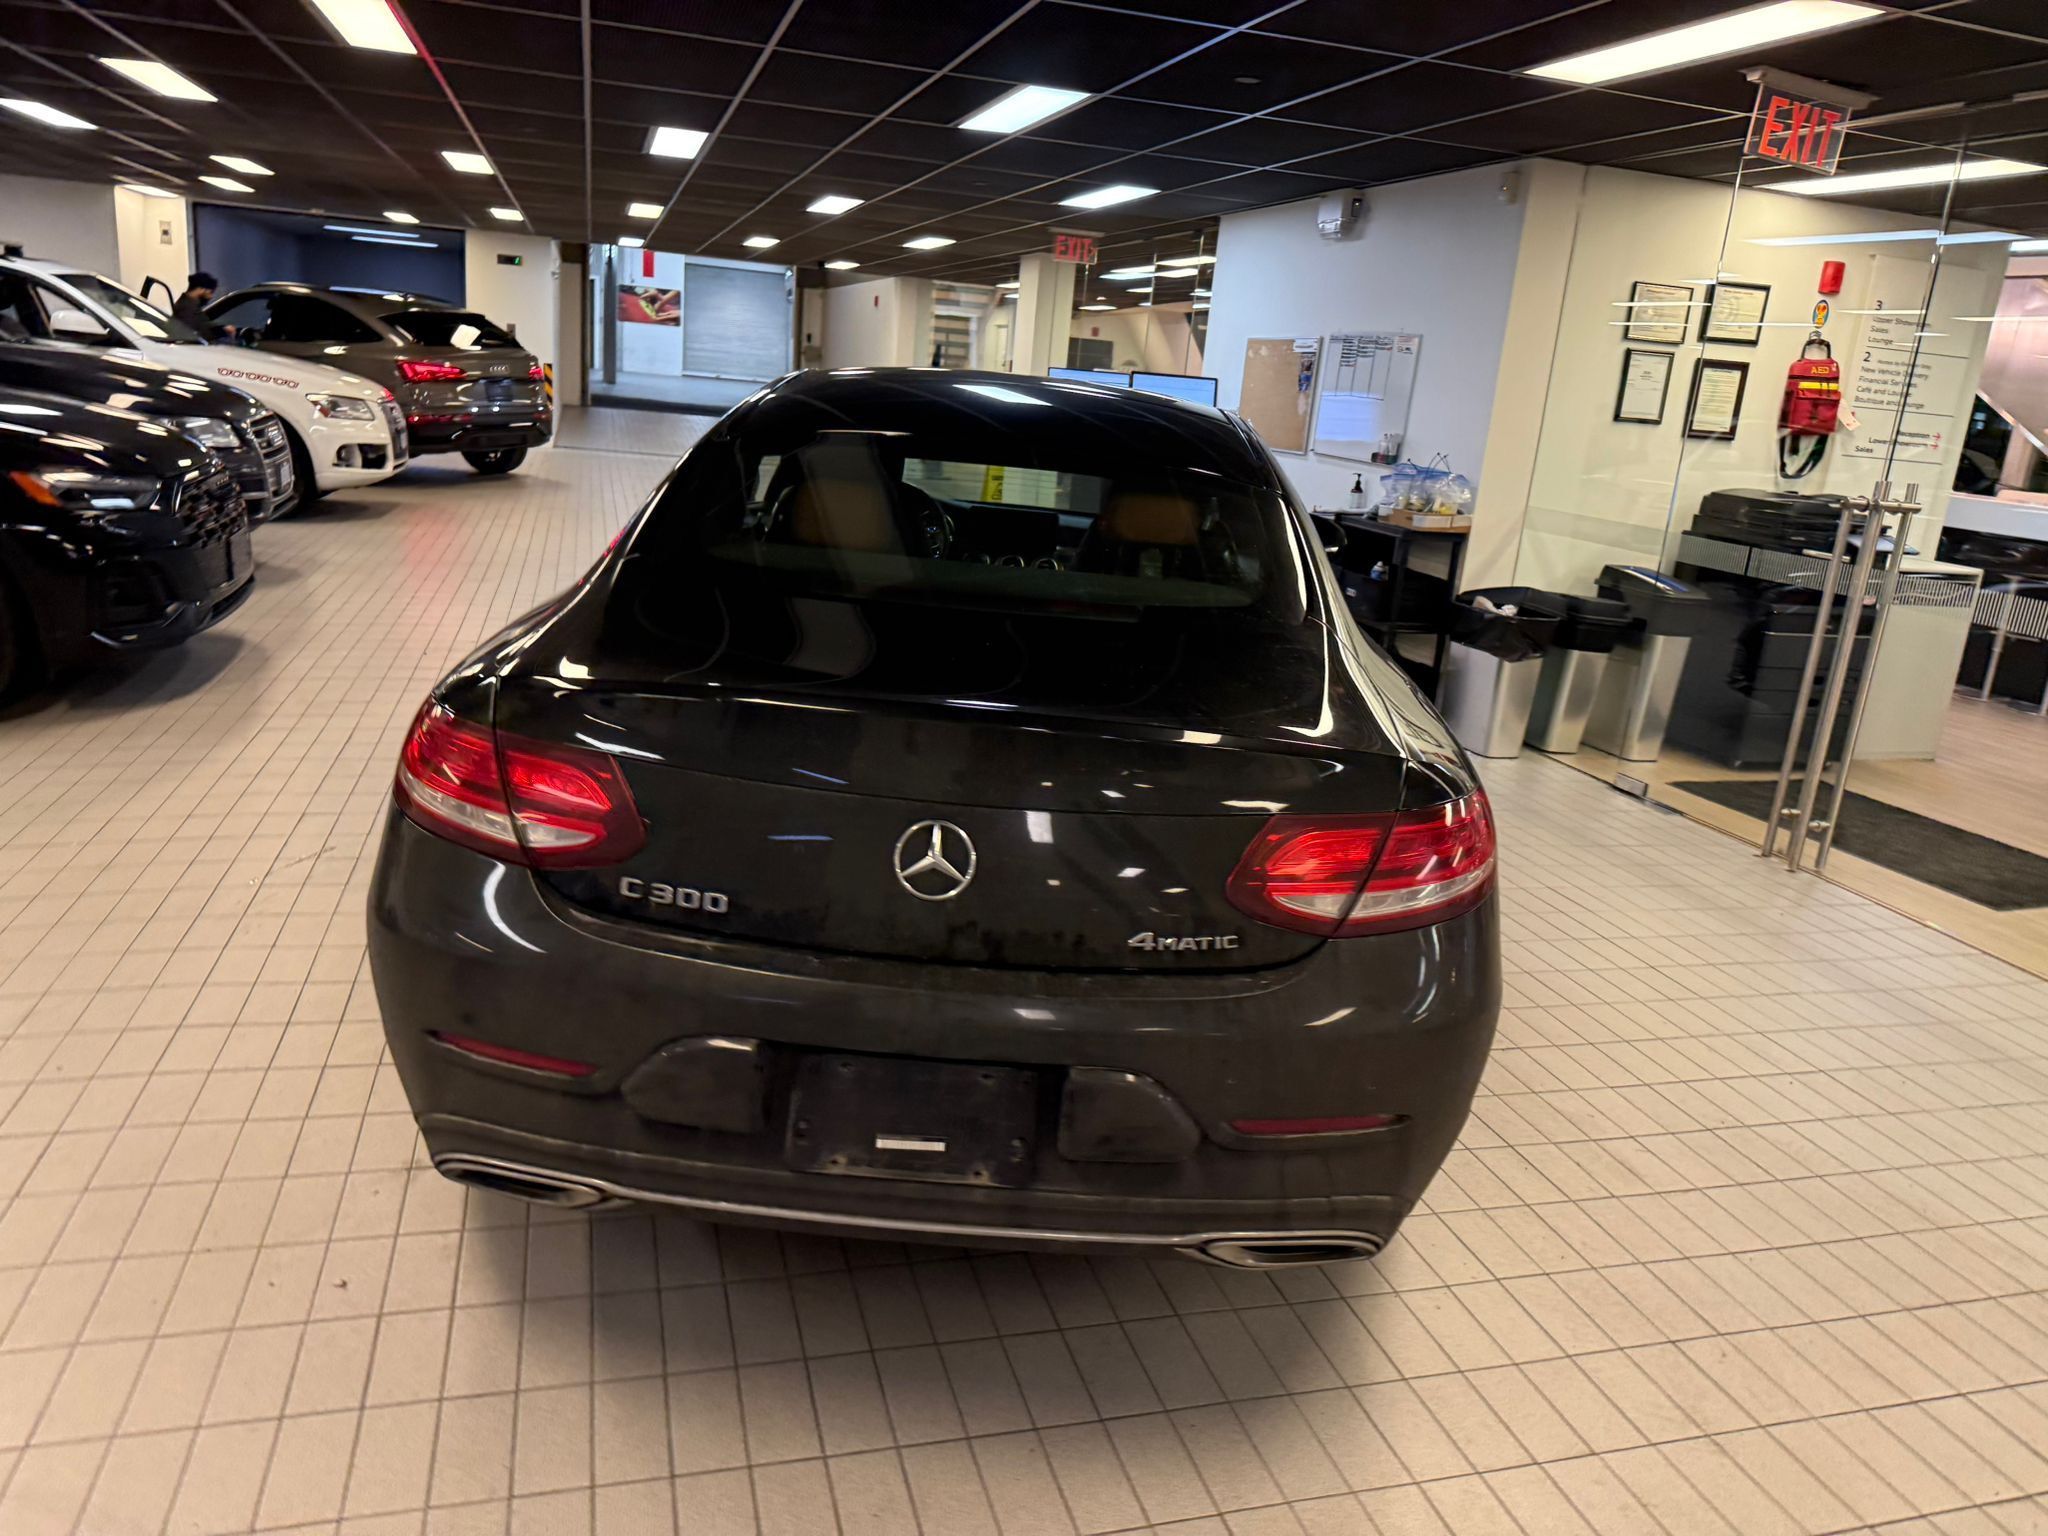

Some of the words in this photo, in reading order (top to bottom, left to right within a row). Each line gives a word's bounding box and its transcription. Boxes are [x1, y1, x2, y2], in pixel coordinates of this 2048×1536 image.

[1758, 95, 1842, 168] EXIT
[1056, 235, 1092, 263] EXIT
[1874, 299, 1883, 311] 3
[1863, 351, 1871, 362] 2
[1811, 366, 1830, 375] AED
[1855, 445, 1874, 454] Sales
[619, 876, 645, 899] C
[648, 882, 729, 914] 300
[1127, 931, 1240, 951] 4MATIC
